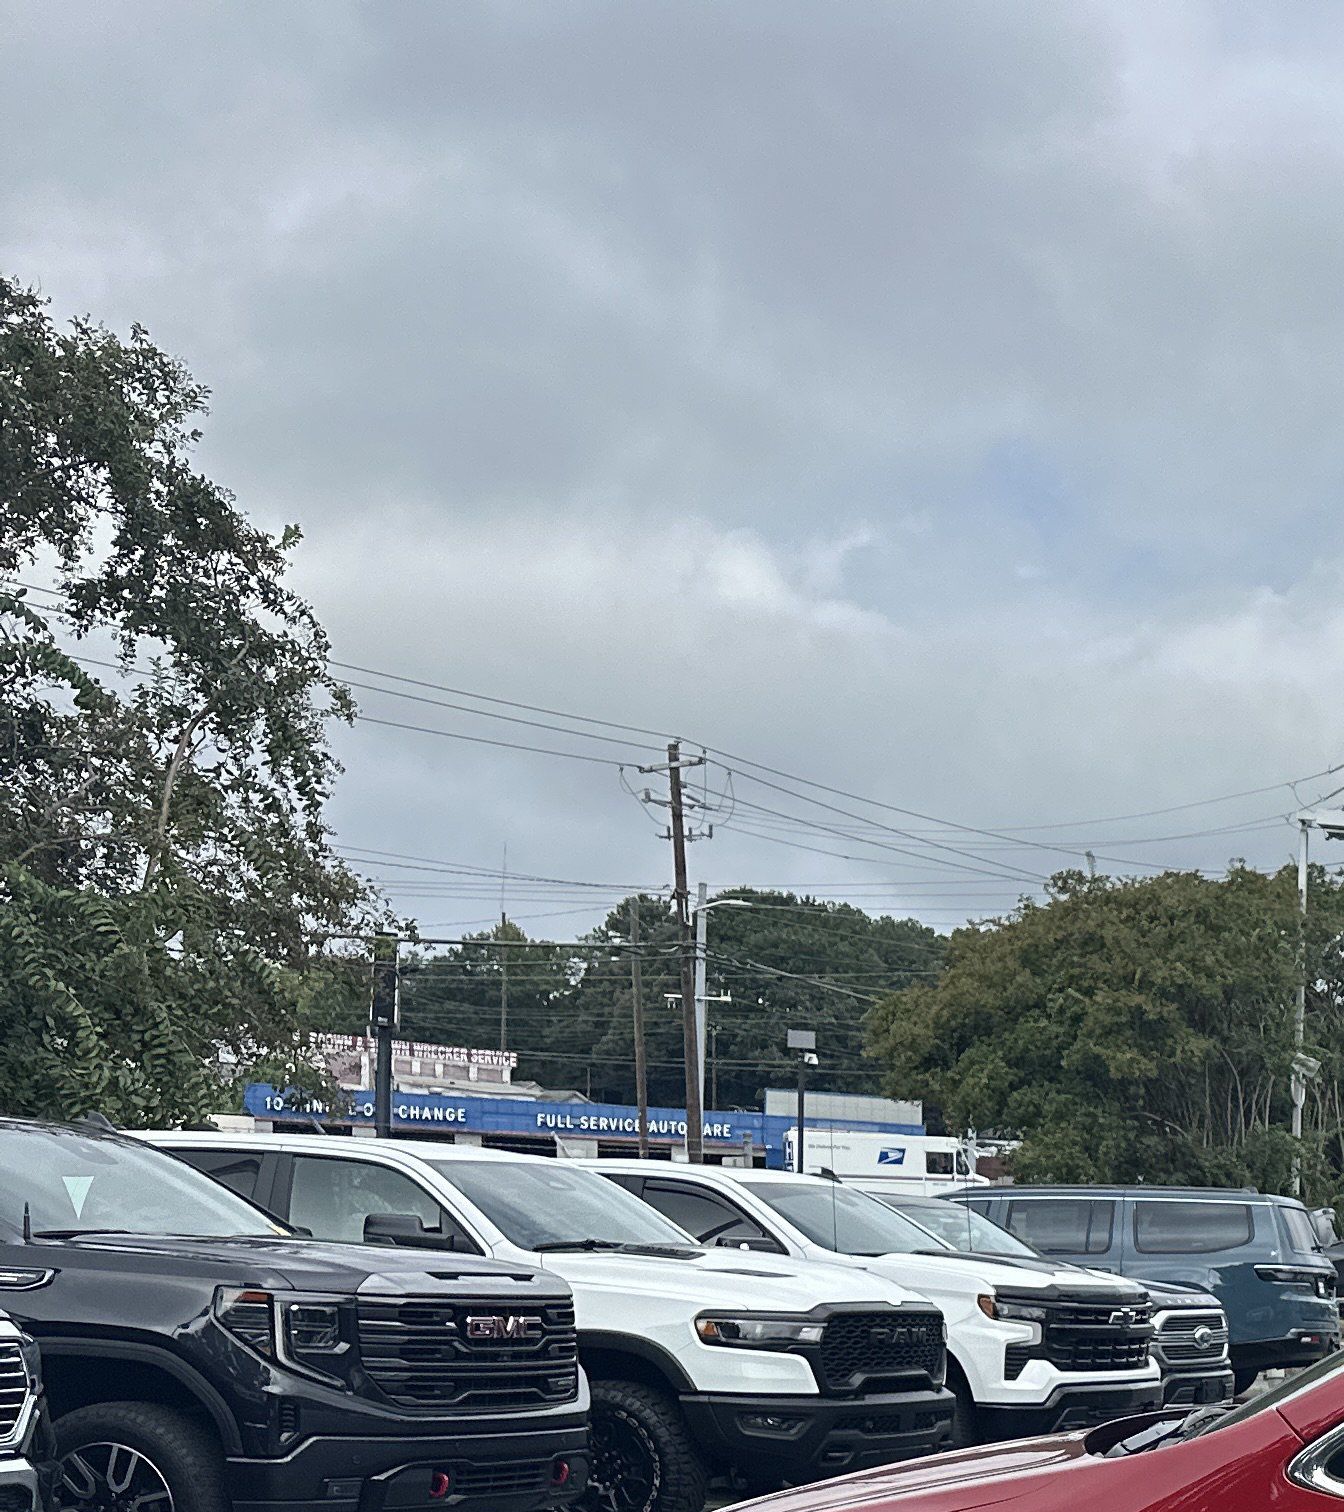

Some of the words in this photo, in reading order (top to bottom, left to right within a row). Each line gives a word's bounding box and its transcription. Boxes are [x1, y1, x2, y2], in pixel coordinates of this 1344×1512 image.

[265, 1096, 284, 1111] 10
[398, 1104, 467, 1122] CHANGE
[536, 1113, 574, 1129] FULL
[648, 1119, 688, 1135] AUTO
[702, 1122, 732, 1138] ARE
[466, 1315, 543, 1339] GMC
[870, 1327, 927, 1344] RAM
